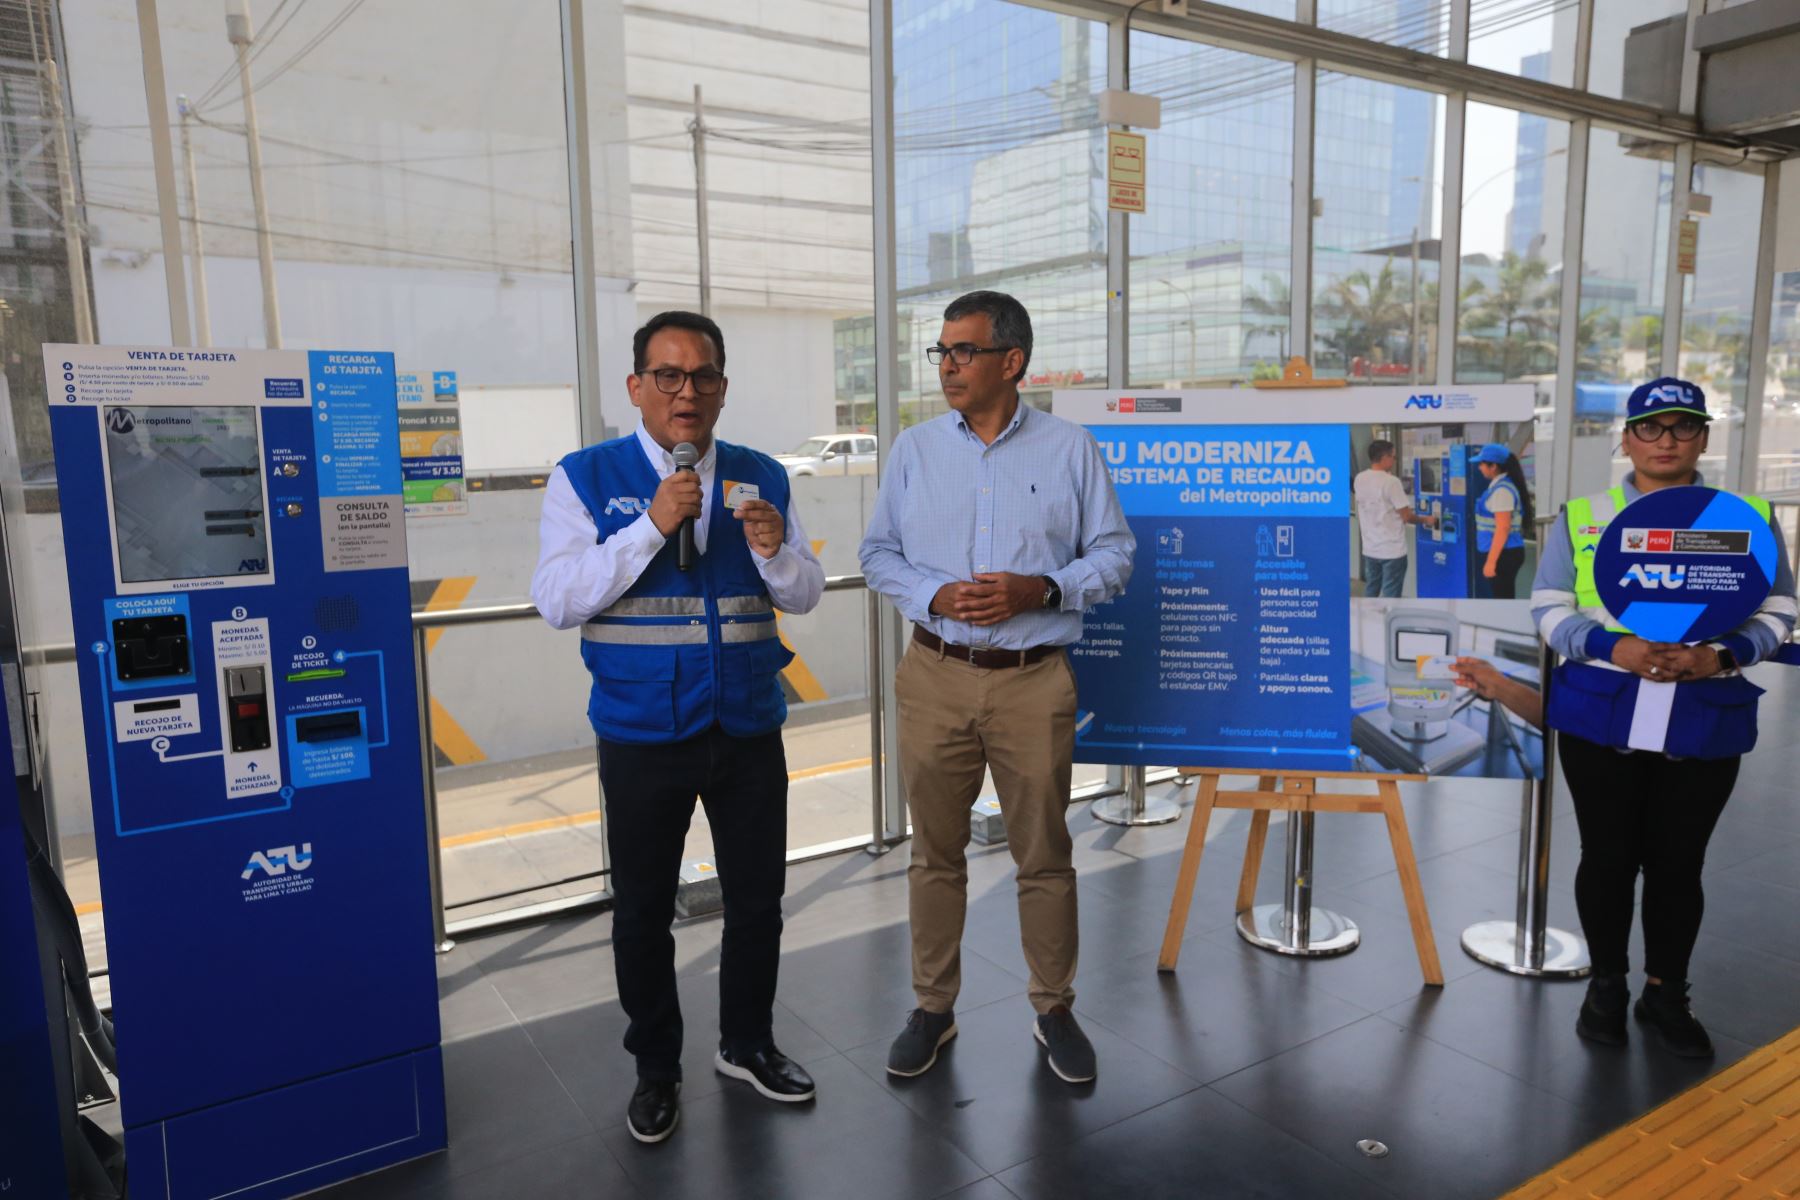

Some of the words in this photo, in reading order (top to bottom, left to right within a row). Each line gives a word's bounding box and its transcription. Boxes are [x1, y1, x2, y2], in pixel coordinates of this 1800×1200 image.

[128, 351, 166, 360] VENTA
[169, 352, 184, 361] DE
[187, 352, 236, 362] TARJETA
[328, 355, 376, 364] RECARGA
[64, 362, 72, 370] A
[324, 365, 337, 374] DE
[339, 366, 383, 375] TARJETA
[1644, 384, 1694, 406] ATU
[1404, 394, 1442, 409] ATU
[1138, 440, 1315, 465] MODERNIZA
[273, 467, 282, 476] A
[432, 468, 442, 476] S/
[443, 467, 461, 475] 3.50
[1109, 467, 1190, 485] ISTEMA
[1196, 467, 1223, 484] DE
[1231, 467, 1331, 485] RECAUDO
[1180, 488, 1205, 503] del
[1210, 488, 1331, 507] Metropolitano
[336, 502, 389, 511] CONSULTA
[604, 496, 651, 515] ATU
[340, 514, 353, 522] DE
[355, 512, 387, 521] SALDO
[359, 522, 390, 530] pantalla)
[1649, 537, 1669, 545] PERÚ
[1686, 538, 1720, 546] Transportes
[238, 558, 266, 572] ATU
[1156, 558, 1177, 568] Más
[1179, 558, 1215, 568] formas
[1255, 559, 1305, 569] Accesible
[1156, 570, 1168, 579] de
[1169, 571, 1194, 582] pago
[1255, 573, 1277, 581] para
[1279, 571, 1308, 580] todos
[1618, 563, 1686, 590] ATU
[1161, 586, 1183, 597] Yape
[1184, 588, 1190, 597] y
[1191, 586, 1209, 595] Plin
[1260, 587, 1278, 596] Uso
[1280, 587, 1299, 596] fácil
[1300, 589, 1320, 598] para
[116, 599, 153, 608] COLOCA
[154, 597, 176, 606] AQUÍ
[1161, 601, 1229, 612] Próximamente:
[1260, 600, 1299, 609] personas
[136, 606, 173, 615] TARJETA
[235, 608, 244, 618] B
[1260, 609, 1317, 619] discapacidad
[1161, 613, 1198, 621] celulares
[1219, 613, 1237, 622] NFC
[221, 626, 260, 635] MONEDAS
[1160, 625, 1179, 633] para
[1181, 625, 1207, 633] pagos
[1209, 624, 1221, 632] sin
[1260, 625, 1288, 633] Altura
[220, 634, 263, 643] ACEPTADAS
[305, 637, 314, 647] D
[1091, 638, 1123, 647] puntos
[1160, 634, 1200, 642] contacto.
[1260, 636, 1304, 644] adecuada
[1305, 636, 1330, 645] (sillas
[96, 643, 104, 652] 2
[1072, 647, 1084, 655] de
[1085, 649, 1121, 658] recarga.
[1260, 646, 1271, 654] de
[1273, 646, 1302, 655] ruedas
[1311, 647, 1330, 655] talla
[293, 652, 325, 661] RECOJO
[335, 652, 343, 660] 4
[1160, 649, 1229, 659] Próximamente:
[292, 661, 302, 669] DE
[303, 659, 329, 668] TICKET
[1160, 660, 1191, 670] tarjetas
[1193, 660, 1233, 669] bancarias
[1260, 657, 1281, 666] baja)
[1160, 672, 1165, 680] y
[1167, 671, 1201, 680] códigos
[1202, 671, 1217, 680] QR
[1218, 672, 1237, 681] bajo
[1260, 673, 1299, 682] Pantallas
[1300, 674, 1328, 682] claras
[1169, 681, 1206, 690] estándar
[1208, 683, 1229, 691] EMV.
[1260, 685, 1265, 693] y
[1267, 685, 1296, 694] apoyo
[1297, 686, 1333, 694] sonoro.
[306, 693, 344, 702] RECUERDA:
[341, 697, 362, 705] VUELTO
[134, 717, 169, 726] RECOJO
[171, 715, 182, 723] DE
[127, 726, 156, 735] NUEVA
[158, 722, 193, 732] TARJETA
[1219, 727, 1251, 737] Menos
[1253, 728, 1280, 739] colas,
[1282, 728, 1303, 738] más
[1305, 728, 1338, 740] fluidez
[156, 740, 166, 749] C
[235, 774, 271, 784] MONEDAS
[231, 780, 278, 792] RECHAZADAS
[241, 842, 312, 880] ATU
[242, 884, 286, 896] TRANSPORTE
[286, 878, 314, 888] URBANO
[253, 876, 292, 888] AUTORIDAD
[245, 895, 262, 903] PARA
[286, 885, 312, 894] CALLAO
